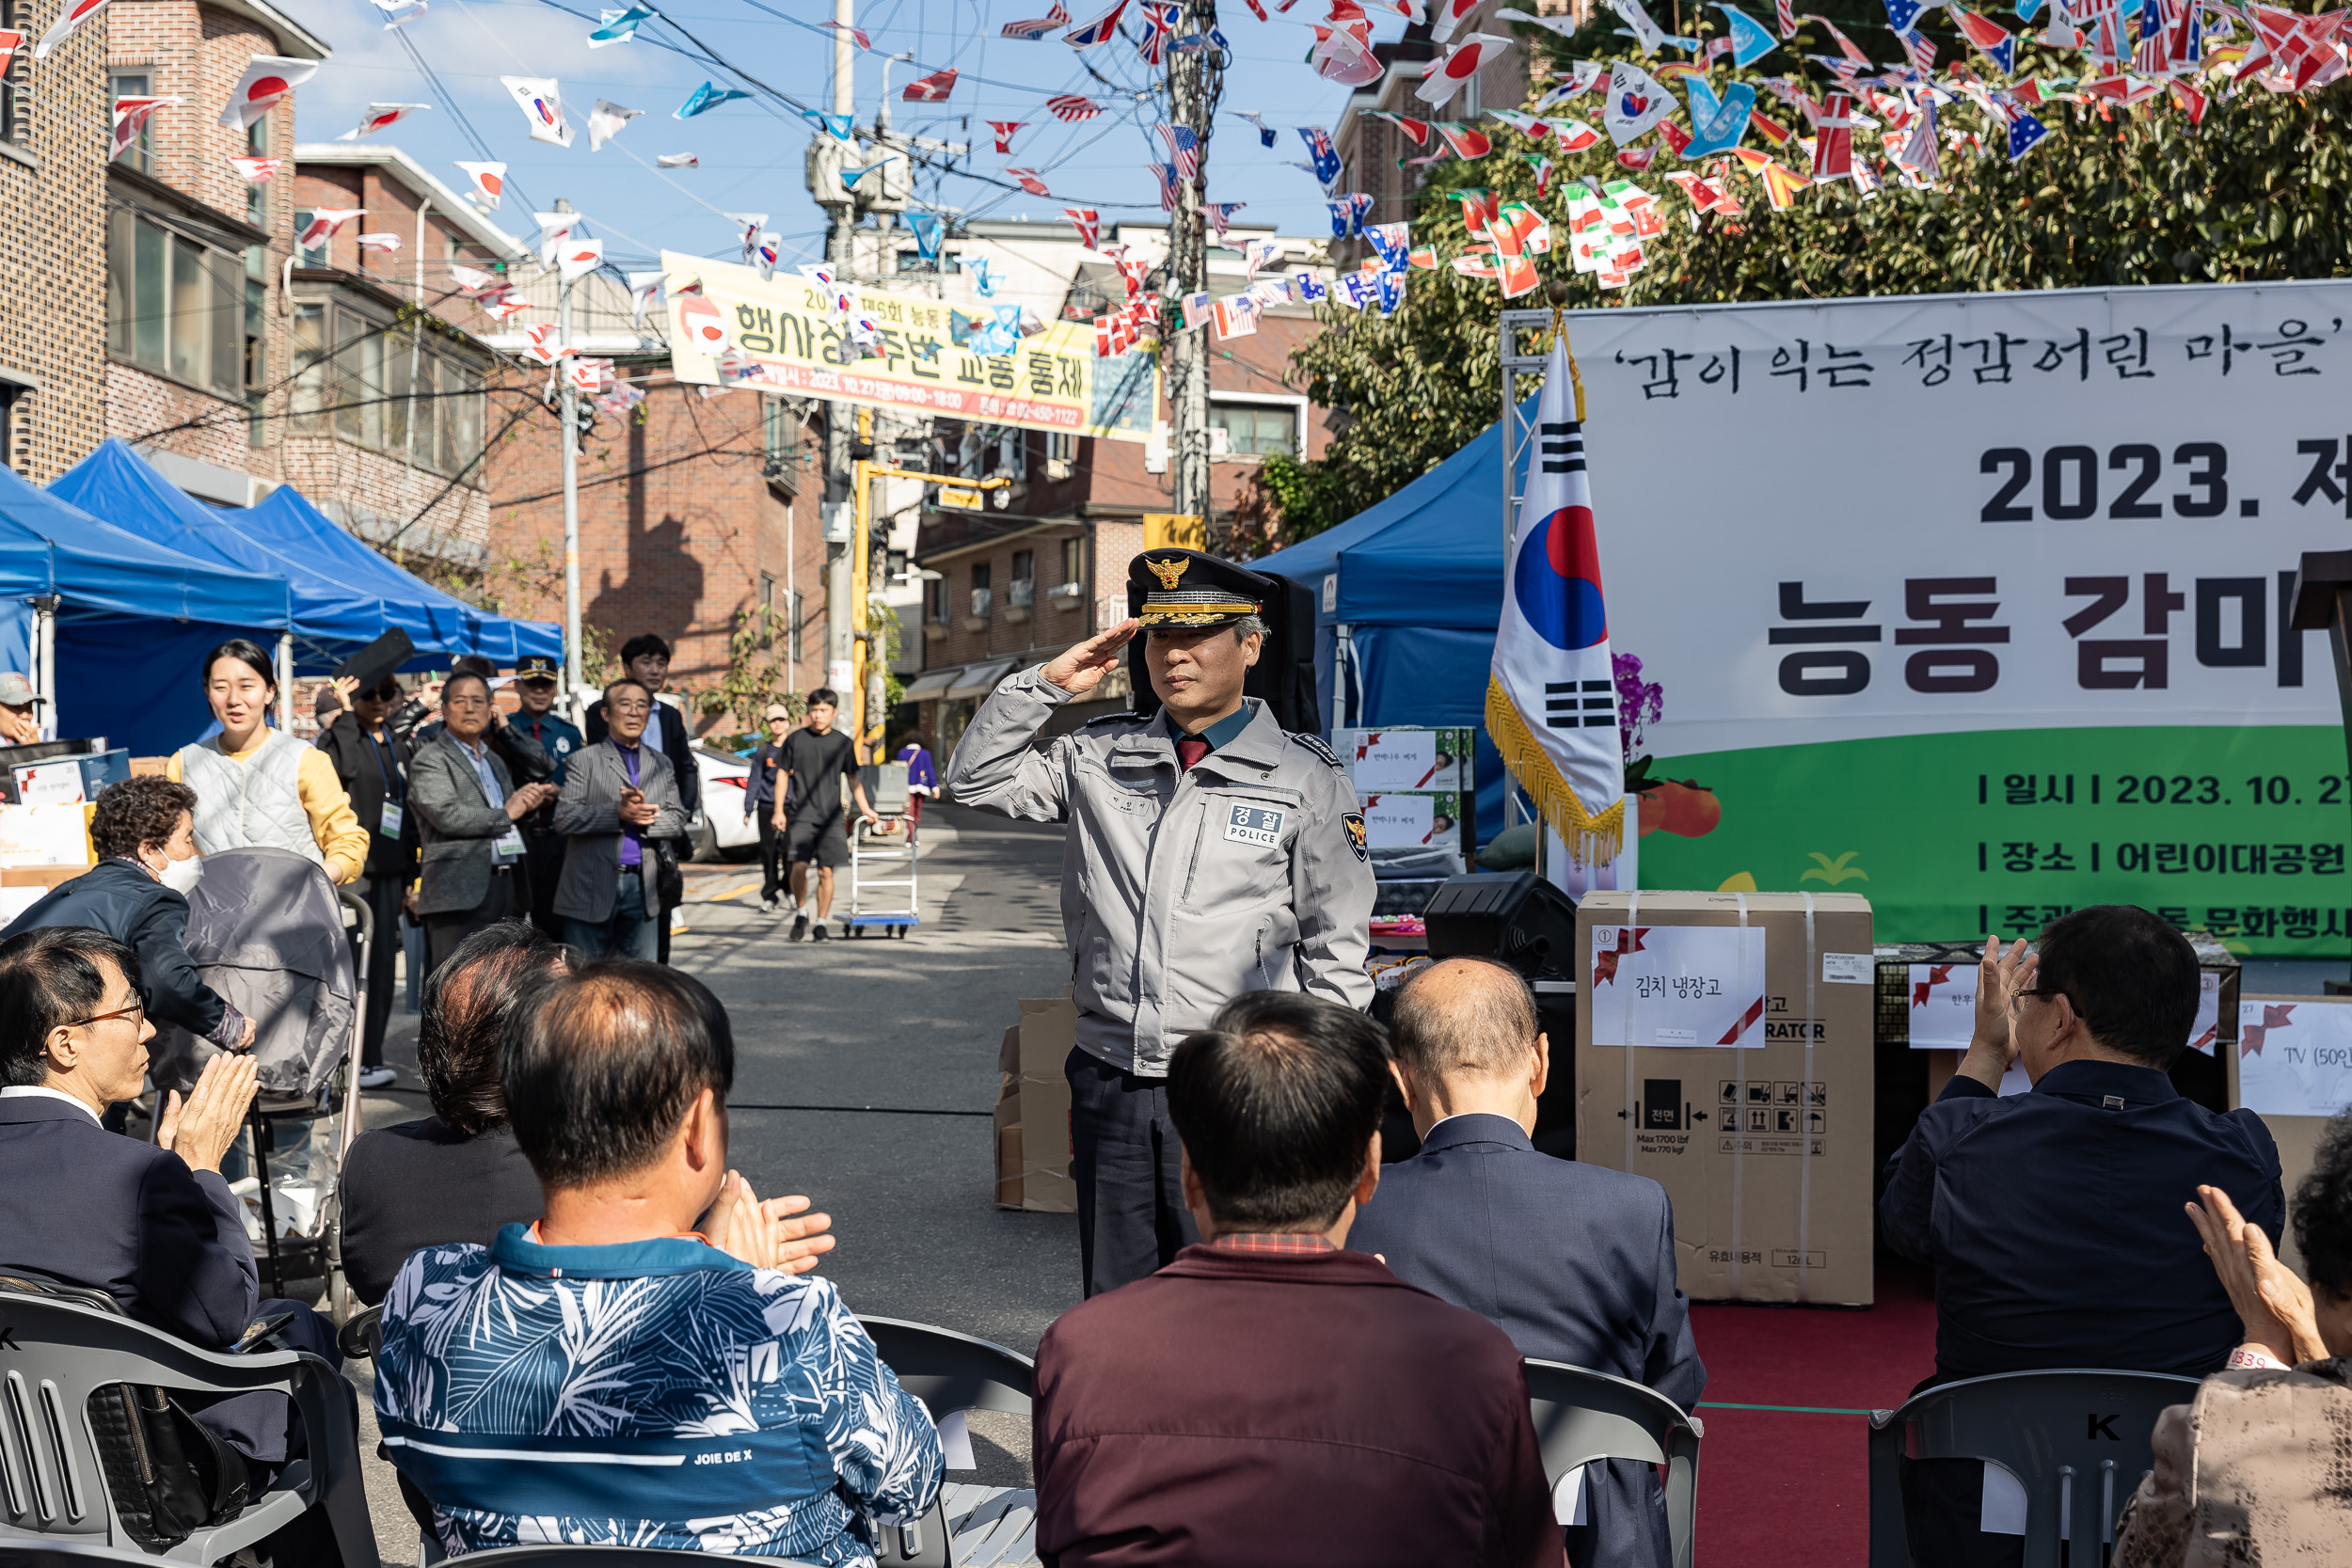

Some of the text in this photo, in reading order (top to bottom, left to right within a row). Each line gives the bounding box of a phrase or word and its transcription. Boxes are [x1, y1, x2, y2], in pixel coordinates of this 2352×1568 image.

[1769, 337, 1876, 394] 익는
[1900, 325, 2156, 388] 정감어린
[1028, 351, 1082, 400] 통제
[1979, 441, 2260, 523] 2023.
[1767, 576, 2011, 698] 능동
[2003, 774, 2352, 806] 일시 2023. 10. 2
[1231, 827, 1277, 844] POLICE
[2002, 841, 2346, 876] 장소 어린이대공원
[1635, 975, 1723, 999] 김치 냉장고
[2283, 1046, 2308, 1065] TV
[1651, 1108, 1676, 1123] 전면
[1637, 1134, 1655, 1144] Max
[1656, 1134, 1677, 1144] 1700
[1641, 1145, 1657, 1153] Max
[1658, 1145, 1672, 1154] 770
[2087, 1413, 2122, 1442] K
[693, 1449, 754, 1466] JOIE DE X
